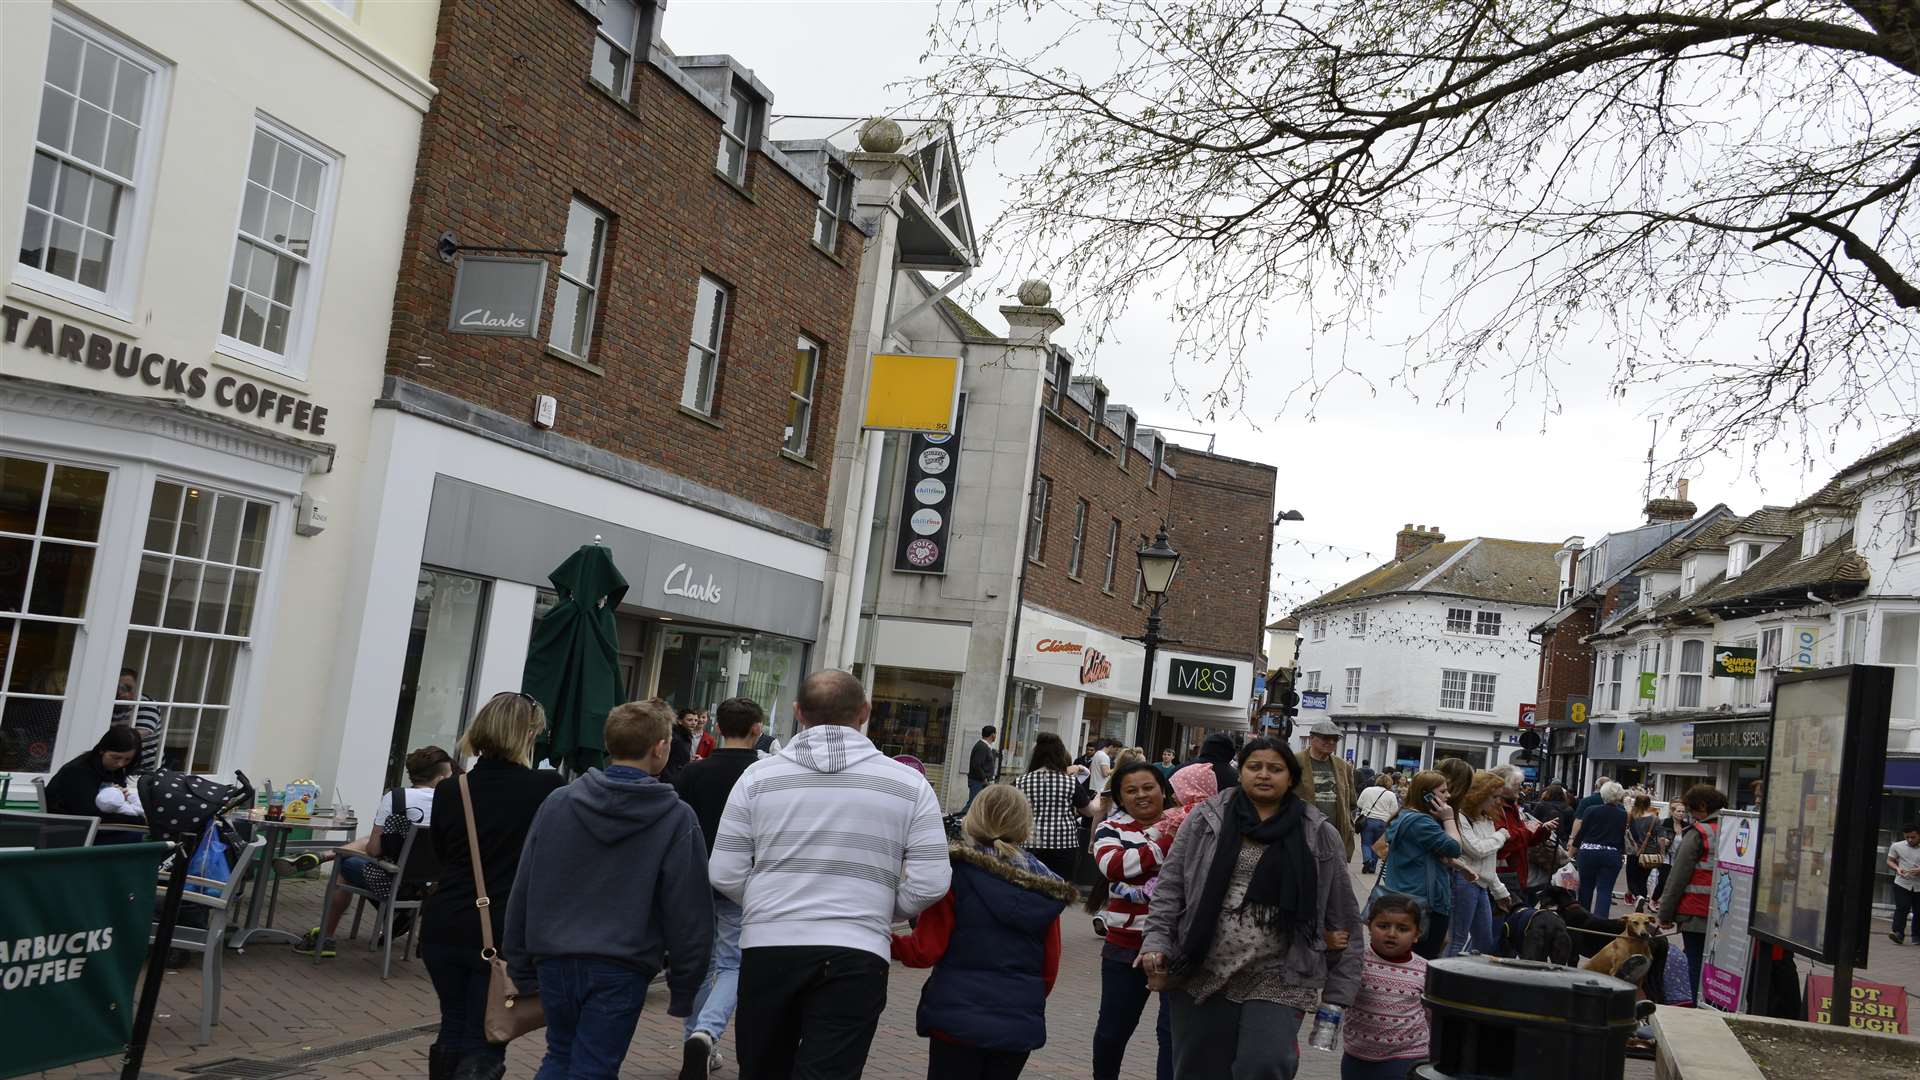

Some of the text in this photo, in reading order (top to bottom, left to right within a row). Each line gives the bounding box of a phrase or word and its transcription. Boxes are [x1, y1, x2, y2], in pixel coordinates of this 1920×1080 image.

[460, 309, 526, 328] Clarks
[214, 376, 329, 436] COFFEE
[912, 541, 933, 550] COSTA
[663, 562, 721, 604] Clarks
[1721, 655, 1757, 667] SNAPPY
[1177, 665, 1227, 693] M&S
[0, 957, 88, 990] OFFEE
[1850, 986, 1880, 1001] OT
[1821, 996, 1895, 1018] FESH
[1816, 1011, 1899, 1034] DUGH
